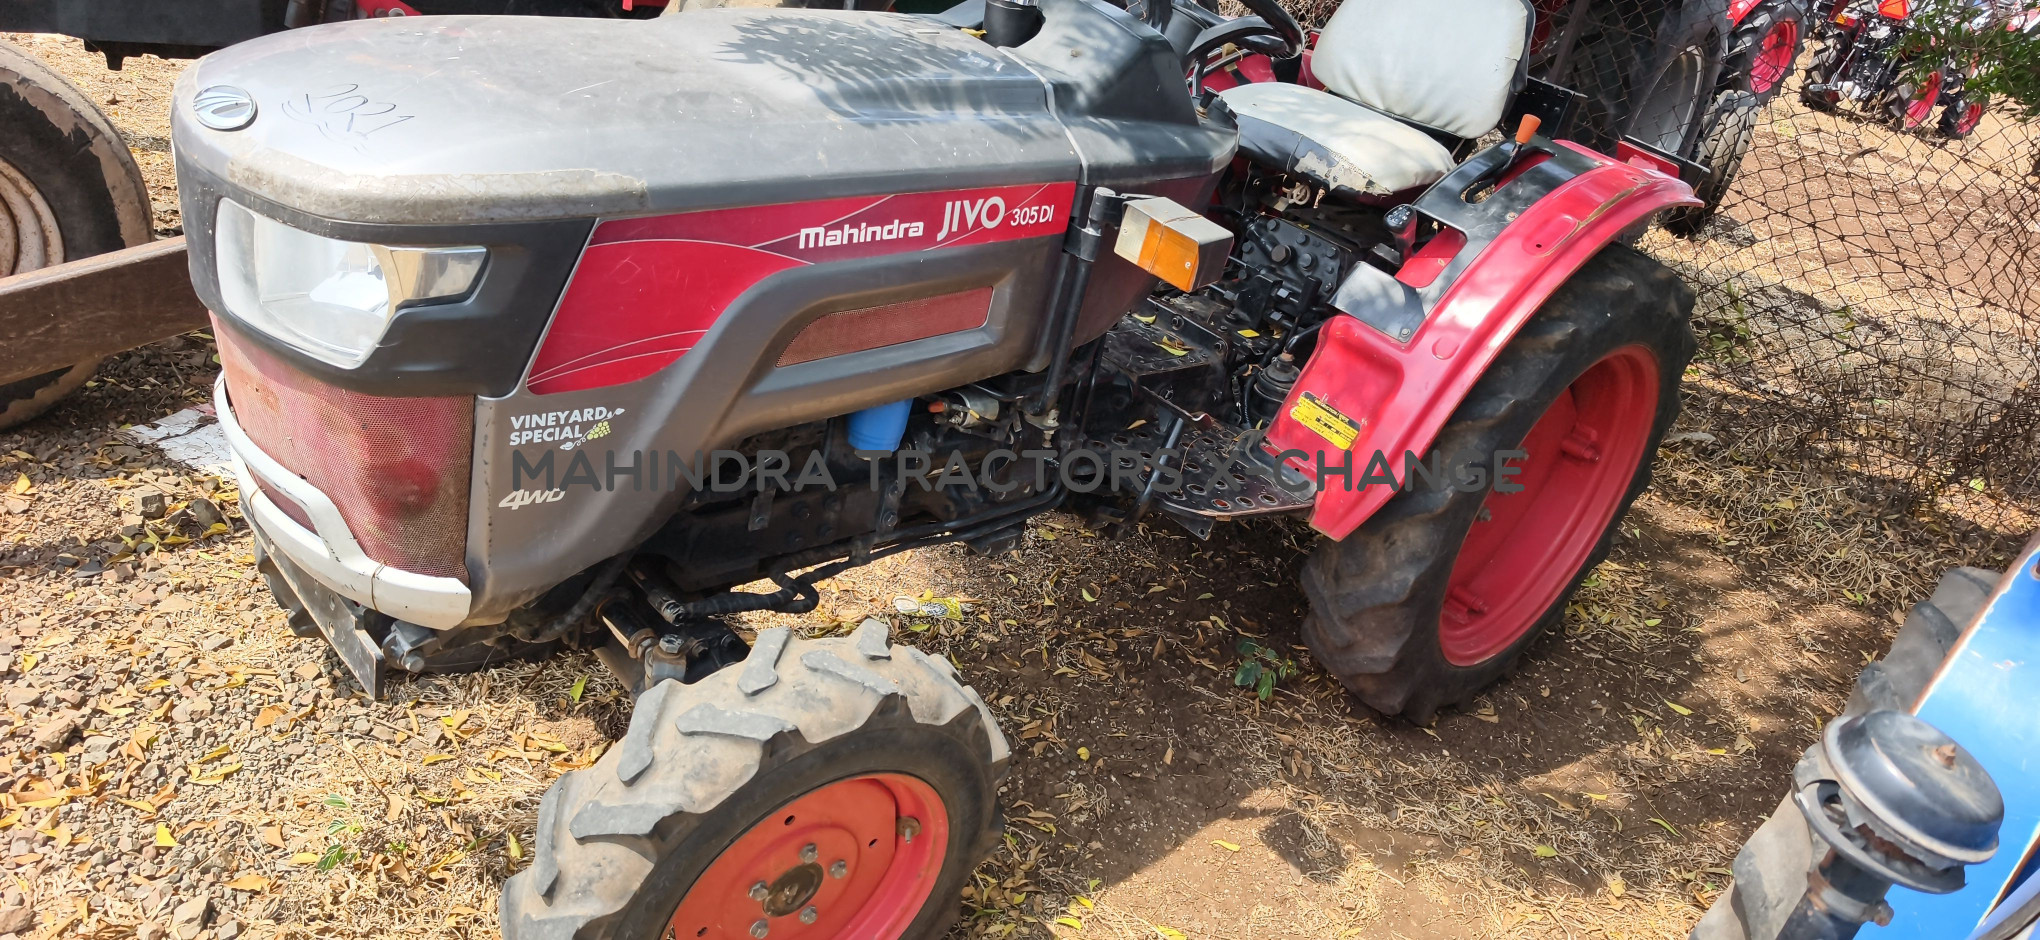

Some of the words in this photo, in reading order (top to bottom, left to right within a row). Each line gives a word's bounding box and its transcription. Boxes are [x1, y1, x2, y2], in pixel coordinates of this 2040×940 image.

[798, 219, 925, 249] Mahindra
[936, 195, 1006, 242] JIVO
[510, 406, 608, 430] VINEYARD
[509, 424, 583, 446] SPECIAL
[498, 487, 565, 510] 4WD
